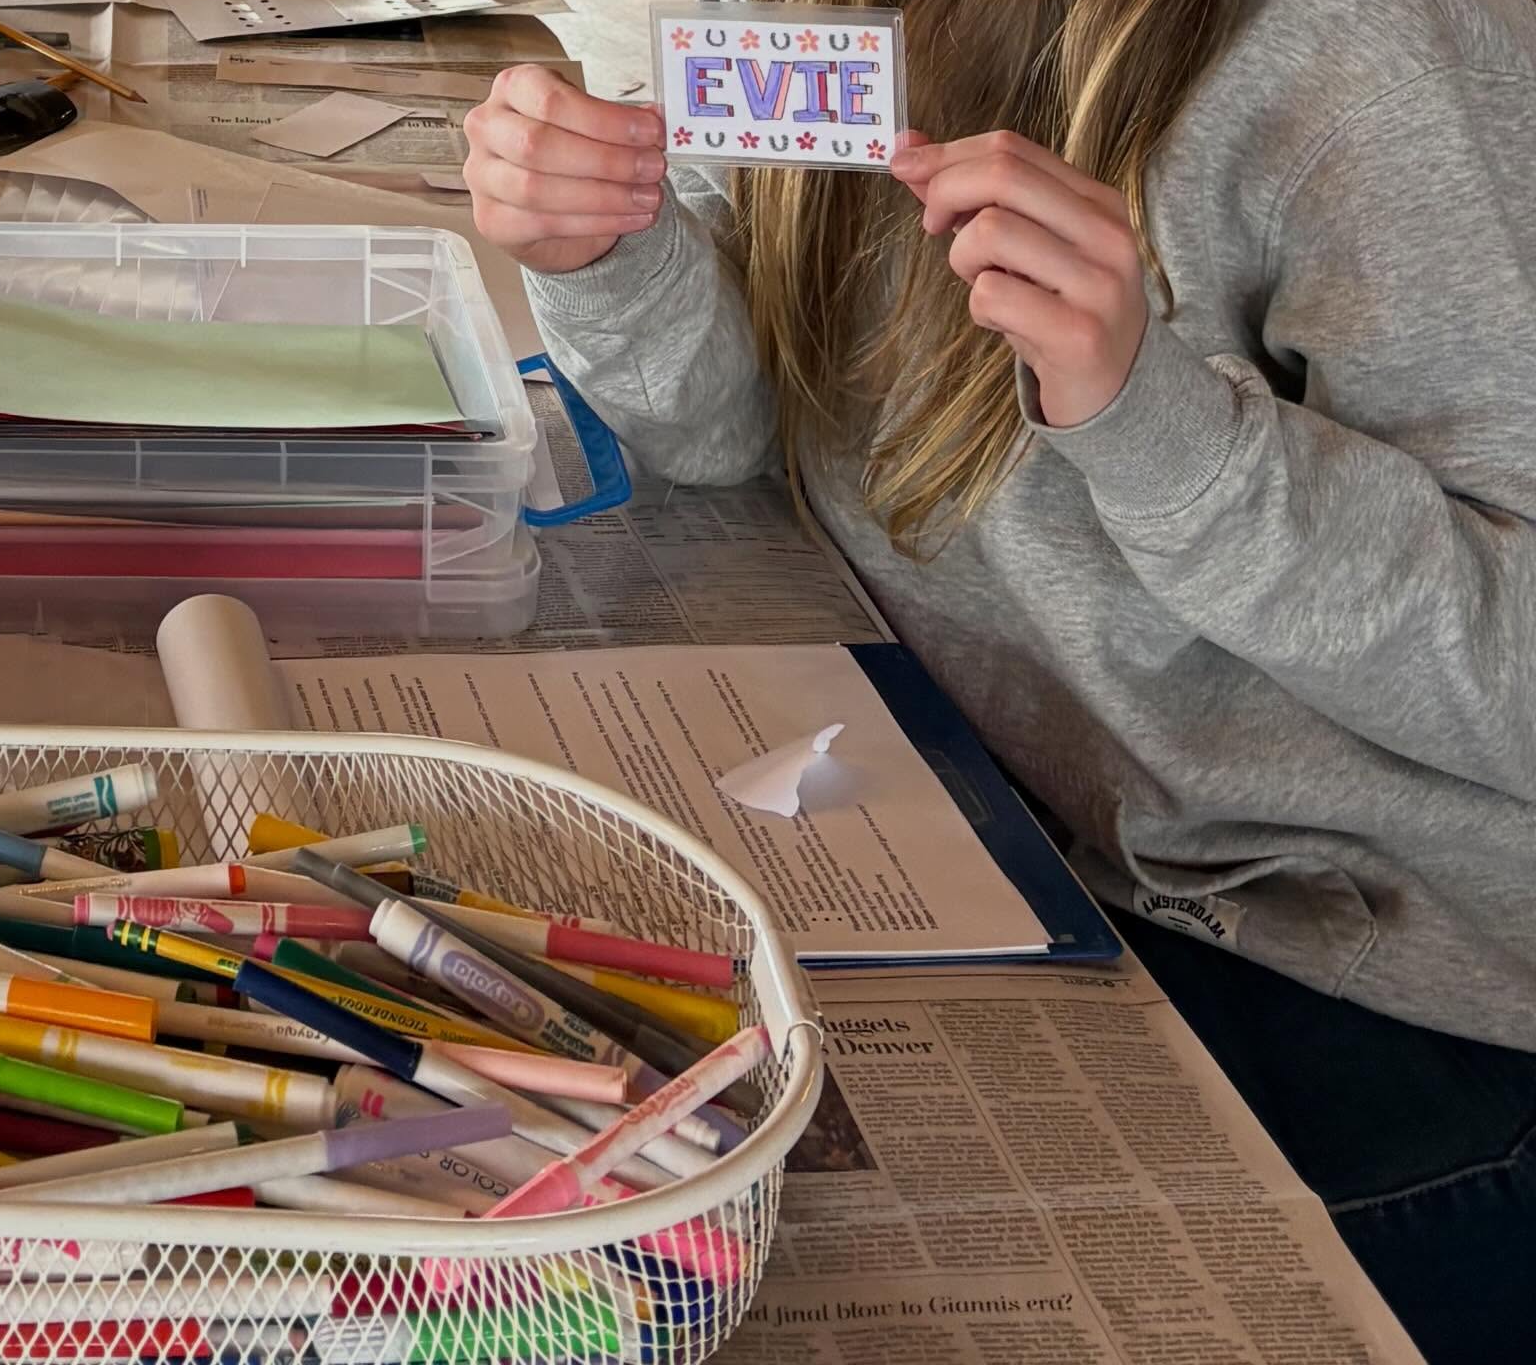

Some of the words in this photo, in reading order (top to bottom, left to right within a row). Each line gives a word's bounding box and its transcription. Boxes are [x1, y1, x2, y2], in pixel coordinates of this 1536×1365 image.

[685, 56, 881, 126] EVIE
[1143, 895, 1225, 939] AMSTERDAM
[449, 957, 538, 1026] Crayola
[822, 1018, 911, 1036] uggets
[835, 1038, 934, 1056] Denver
[438, 1153, 510, 1200] COLOR
[774, 1305, 828, 1327] final
[837, 1300, 893, 1320] blow
[901, 1300, 923, 1316] to
[929, 1295, 1020, 1314] Giannis
[1026, 1293, 1073, 1312] era?
